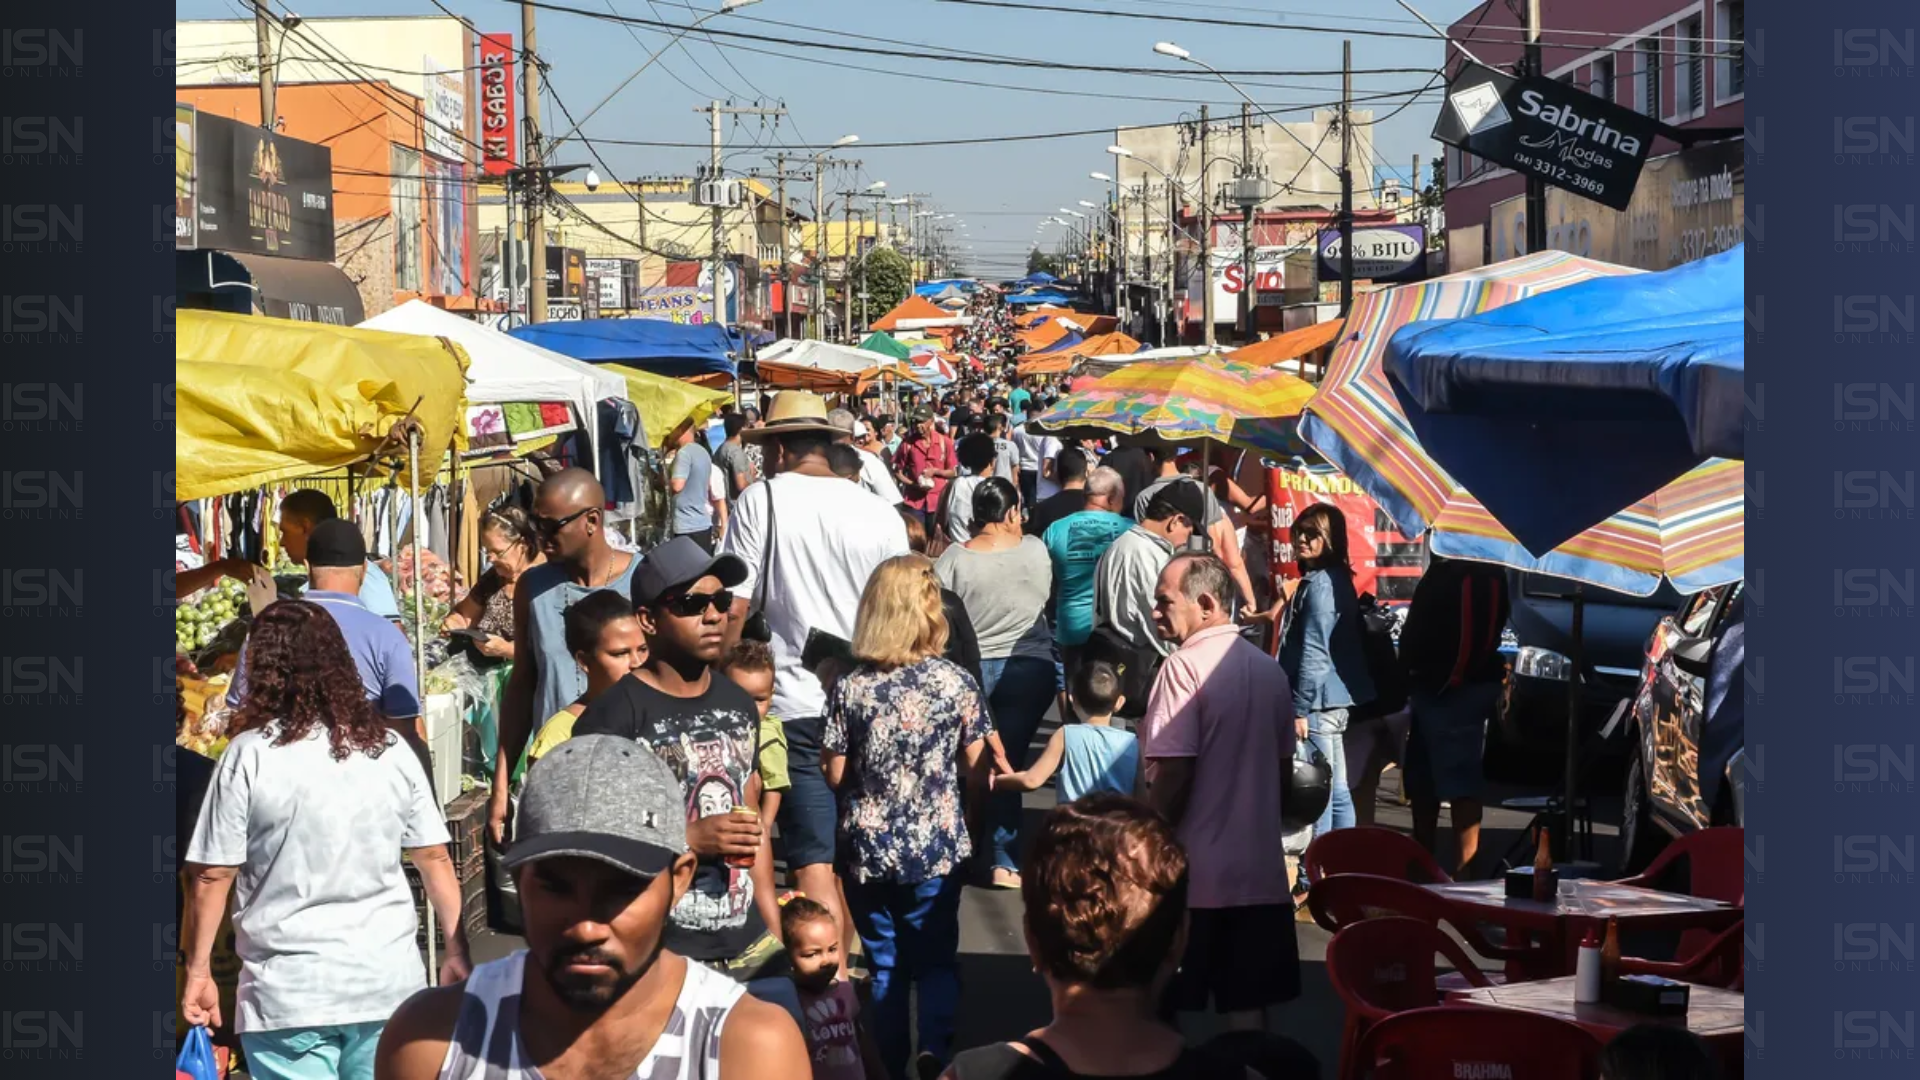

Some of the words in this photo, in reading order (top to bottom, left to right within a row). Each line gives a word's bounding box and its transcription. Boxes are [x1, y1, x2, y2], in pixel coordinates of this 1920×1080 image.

[484, 52, 508, 129] SABOR
[1517, 90, 1641, 157] Sabrina
[1519, 130, 1613, 169] Modas
[1514, 152, 1532, 165] (34)
[1533, 159, 1605, 195] 3312-3969
[1327, 243, 1366, 259] 9%
[1372, 241, 1415, 258] BIJU
[670, 310, 713, 325] kids
[1453, 1063, 1513, 1080] BRAHMA
